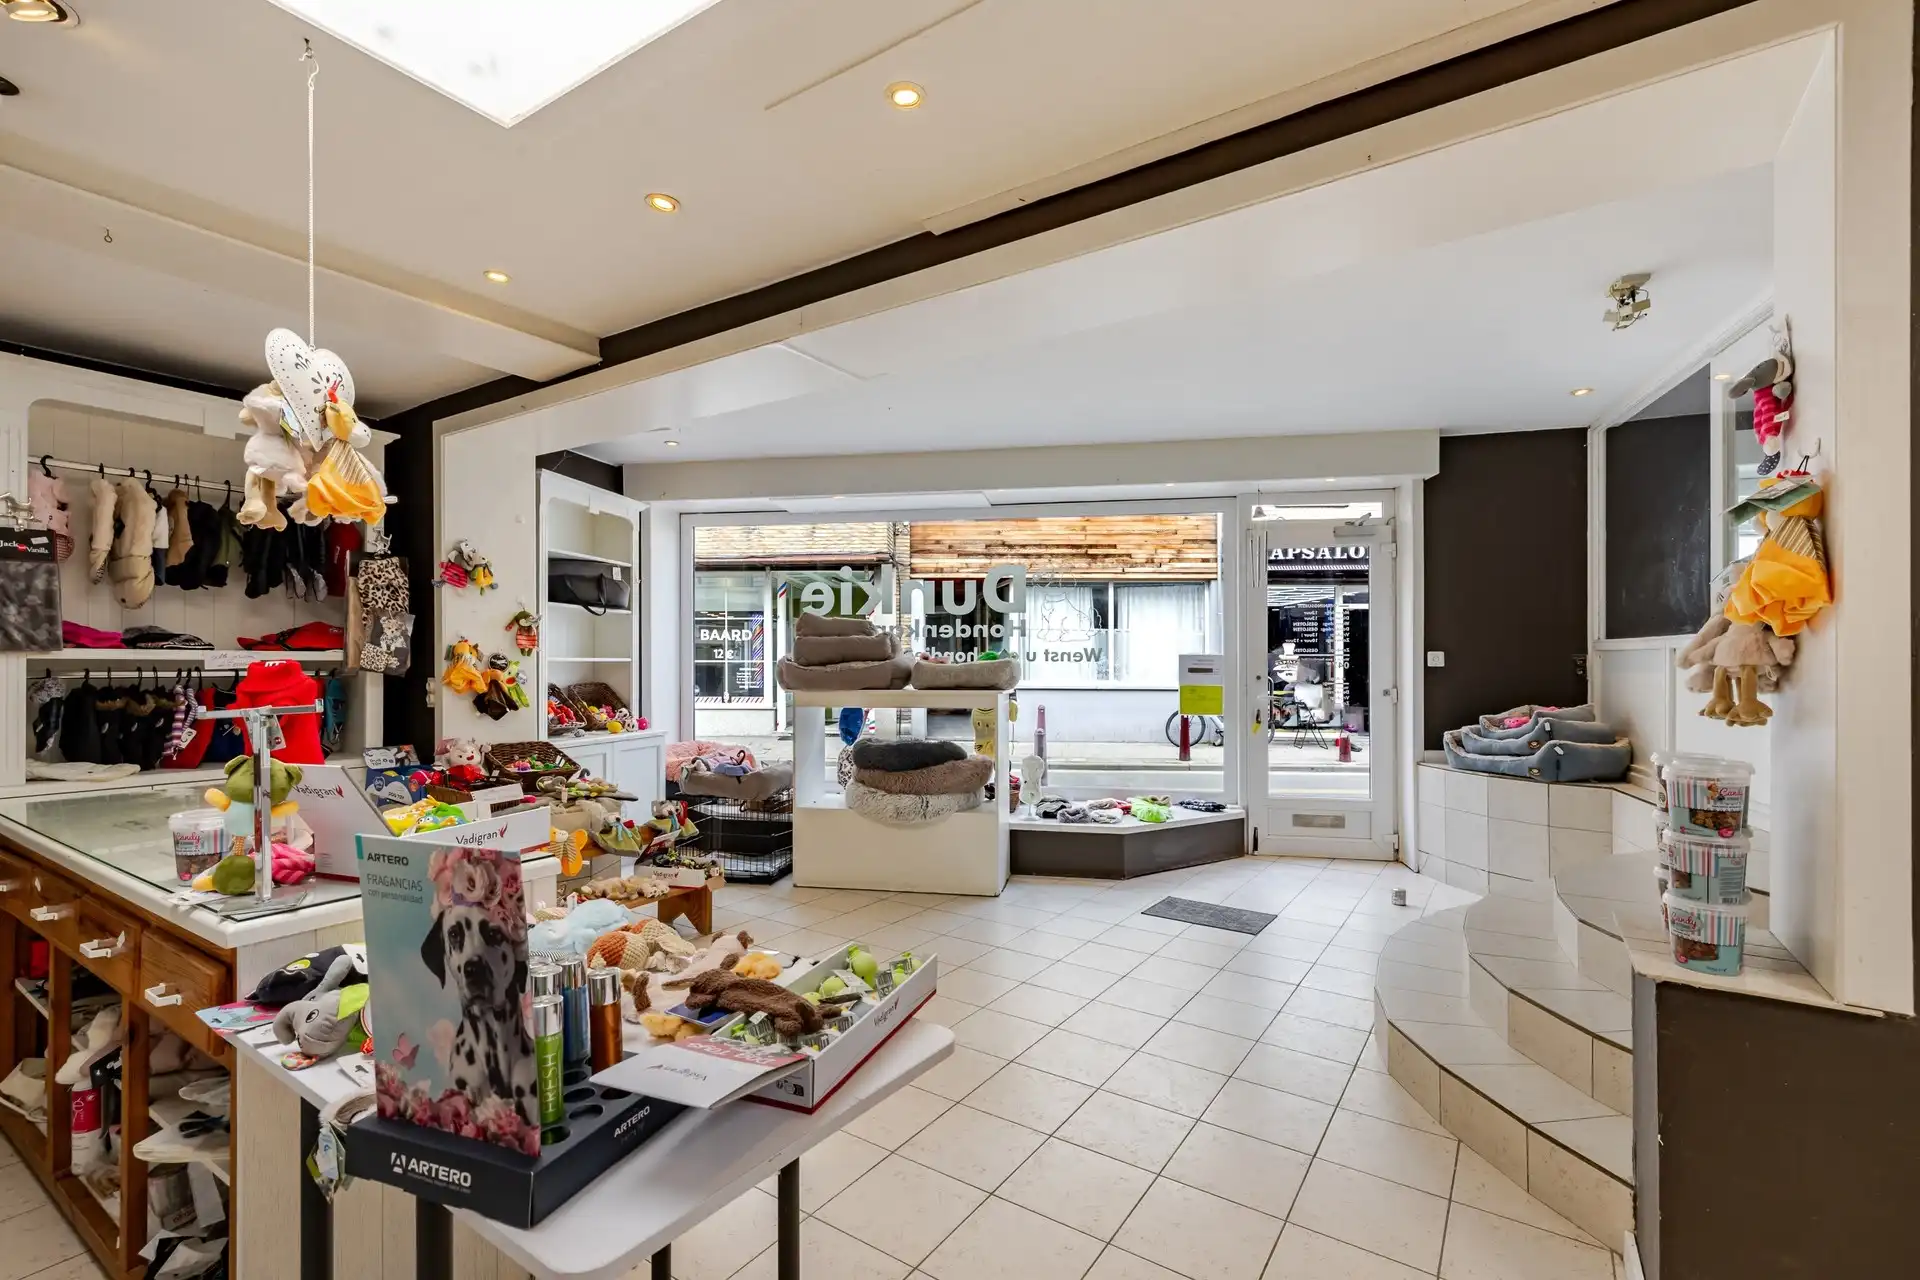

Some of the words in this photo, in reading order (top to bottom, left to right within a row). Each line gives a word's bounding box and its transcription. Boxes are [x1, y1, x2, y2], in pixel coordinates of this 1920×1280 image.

[1269, 547, 1369, 560] APSALO
[700, 629, 752, 641] BAARD
[713, 648, 724, 659] 12
[292, 784, 336, 799] Vadigran
[456, 831, 498, 846] Vadigran
[367, 852, 409, 866] ARTERO
[366, 873, 423, 892] FRAGANCIAS
[368, 888, 380, 897] con
[541, 1052, 558, 1114] FRESH
[613, 1105, 651, 1138] ARTERO
[408, 1157, 472, 1188] ARTERO
